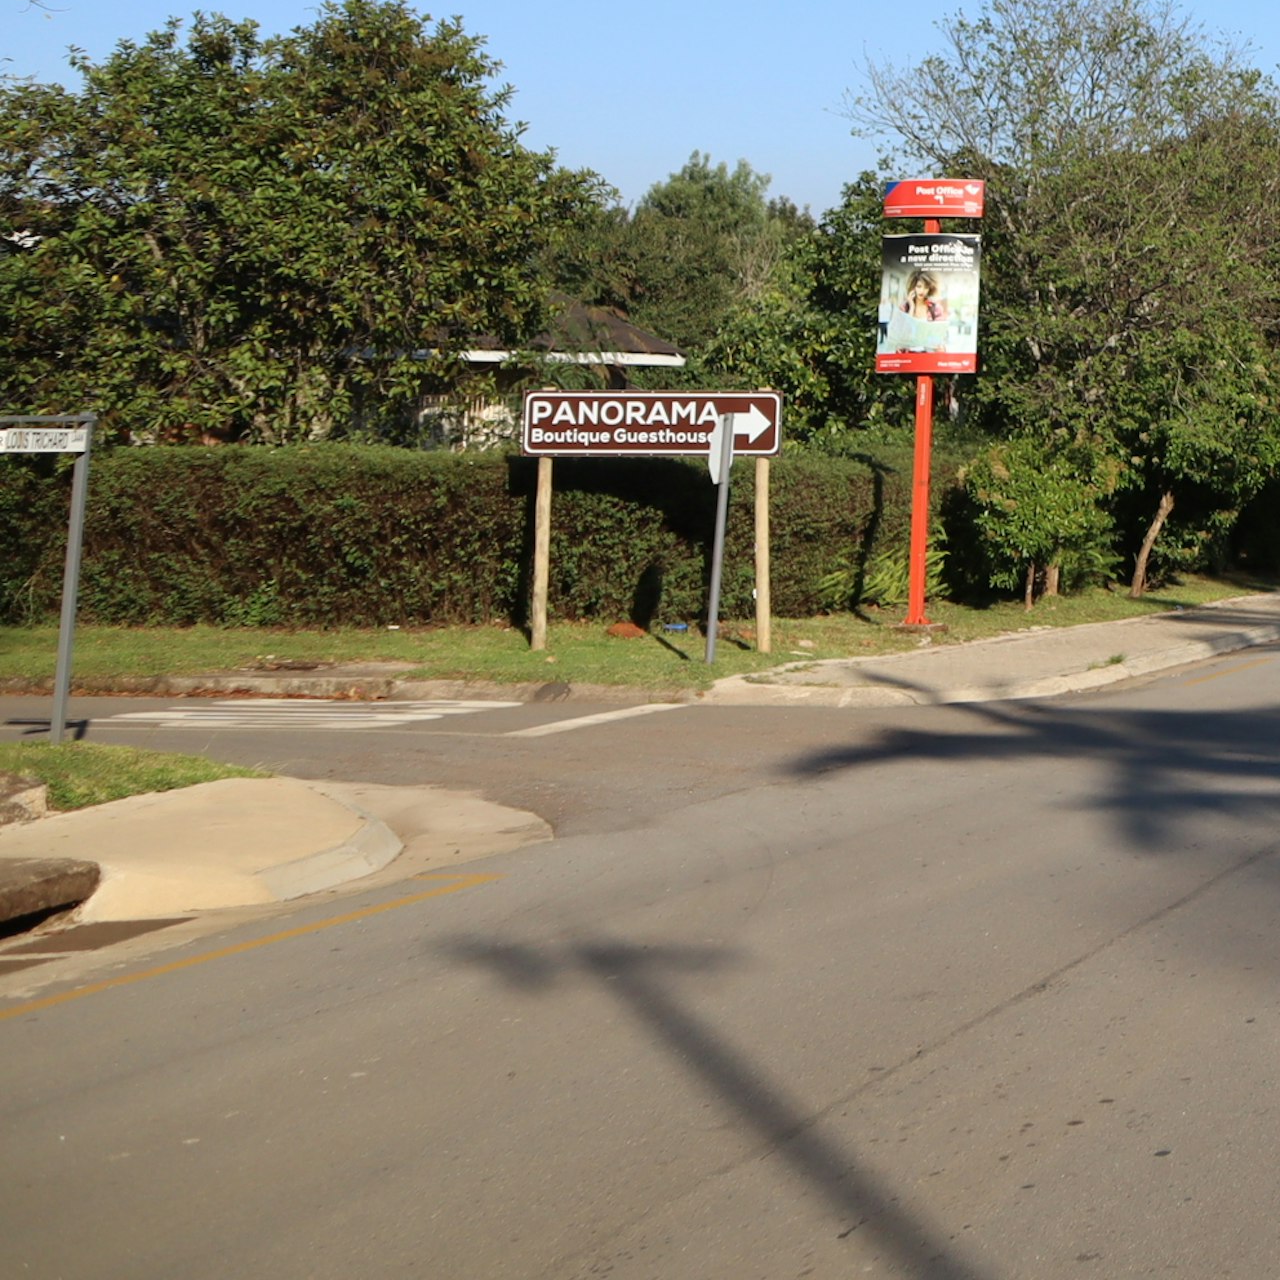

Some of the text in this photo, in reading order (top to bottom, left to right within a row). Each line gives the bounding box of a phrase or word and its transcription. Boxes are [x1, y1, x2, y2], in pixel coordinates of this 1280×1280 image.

[916, 186, 964, 196] Post Office
[908, 244, 929, 254] Post
[908, 255, 927, 263] new
[532, 400, 721, 426] PANORAMA
[7, 431, 30, 449] LOUIS
[531, 428, 610, 446] Boutique
